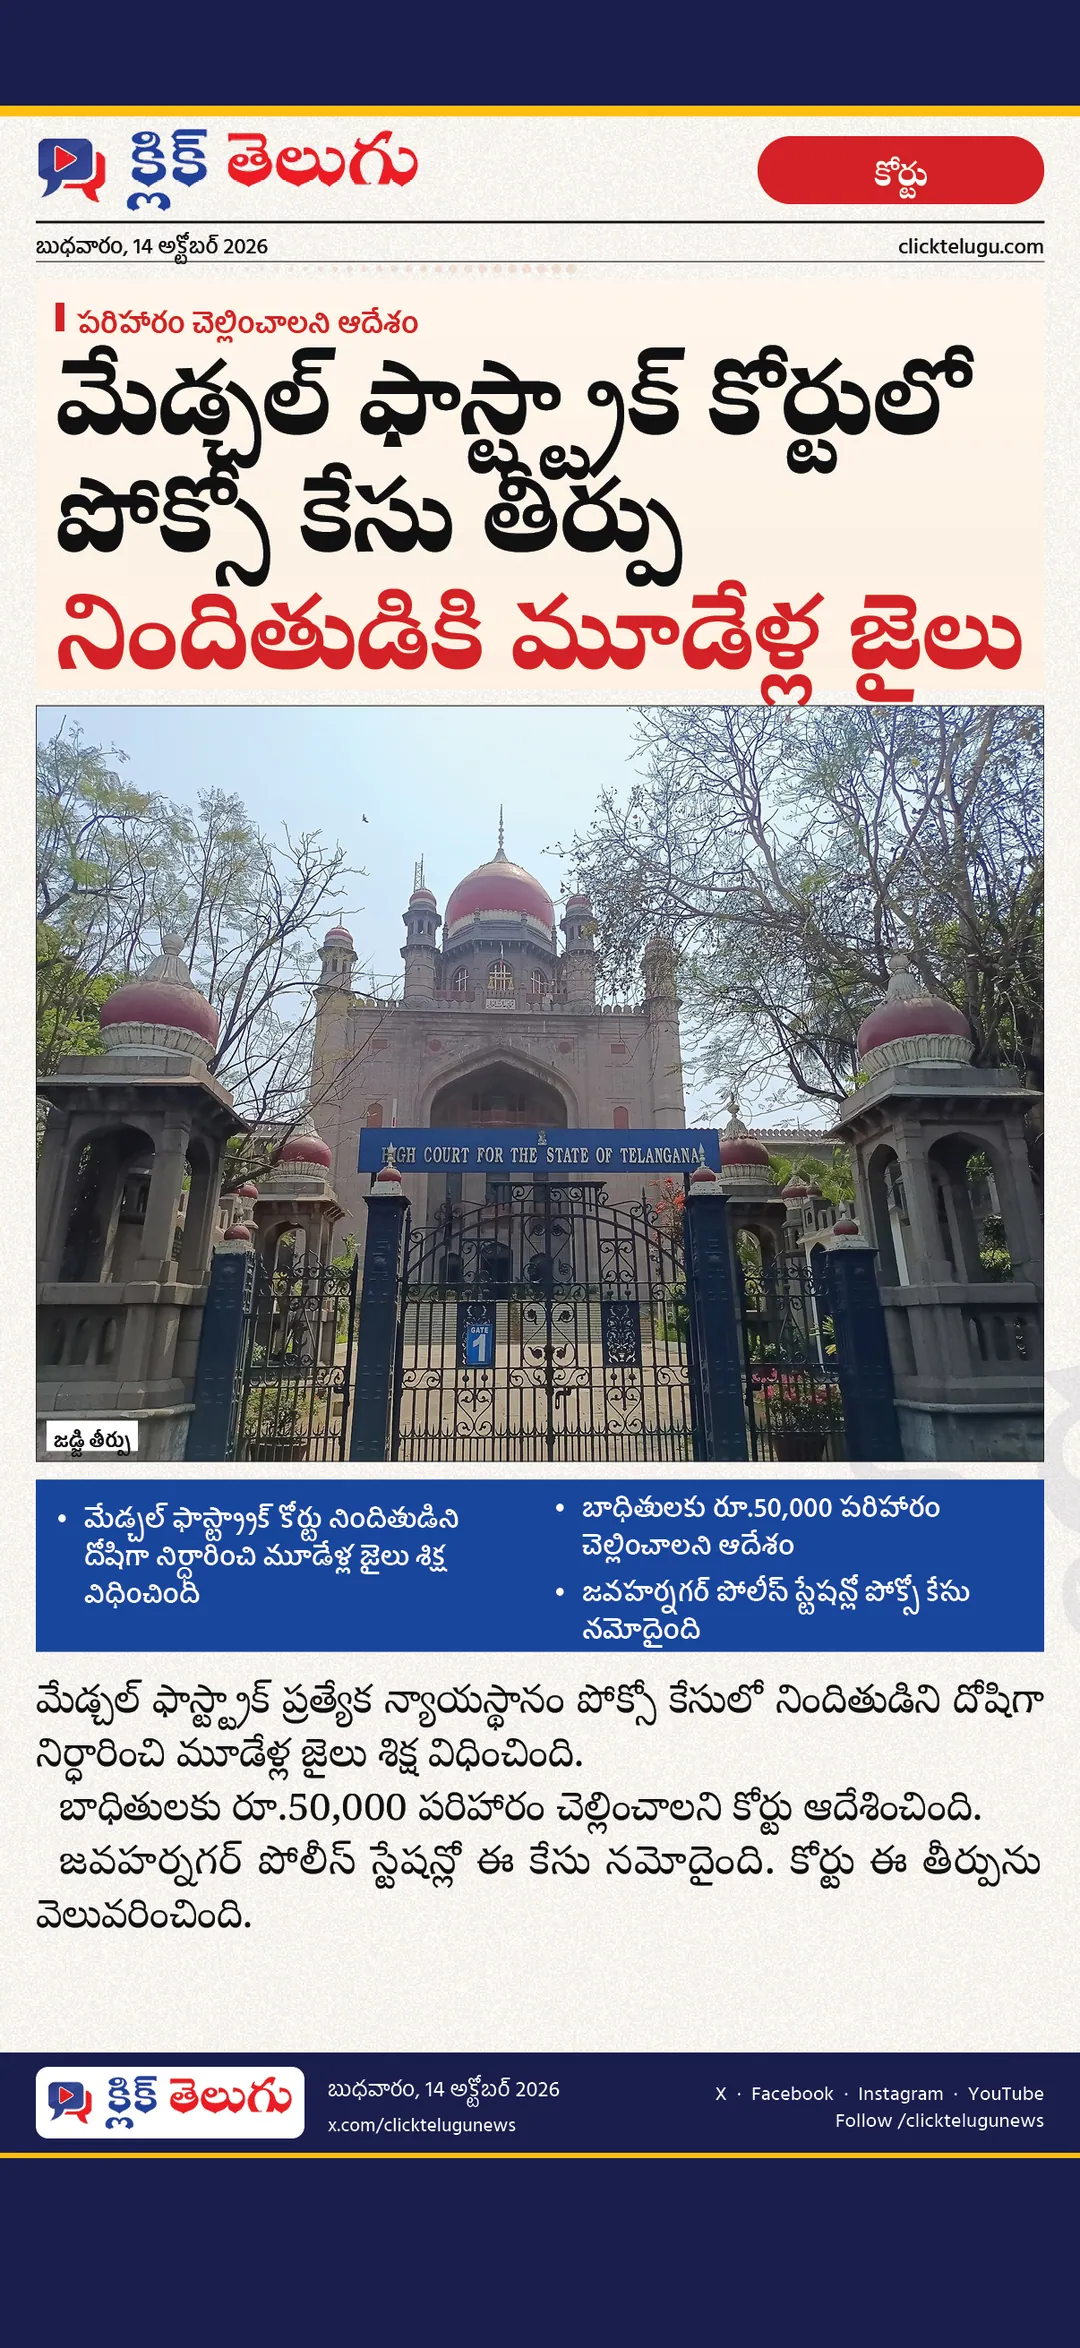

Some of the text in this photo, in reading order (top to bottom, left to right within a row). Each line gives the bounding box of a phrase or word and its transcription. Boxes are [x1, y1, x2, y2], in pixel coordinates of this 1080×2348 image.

[126, 128, 419, 211] క్లిక్ తెలుగు
[874, 155, 928, 200] కోర్టు
[36, 231, 269, 265] బుధవారం, 14 అక్టోబర్ 2026
[898, 237, 1044, 258] clicktelugu.com
[77, 306, 419, 343] పరిహారం చెల్లించాలని ఆదేశం
[57, 345, 336, 470] మేడ్చల్
[708, 344, 975, 475] కోర్టులో
[57, 462, 683, 588] పోక్సో కేసు తీర్పు
[57, 579, 1023, 706] నిందితుడికి మూడేళ్ల జైలు
[424, 1147, 469, 1163] COURT
[477, 1147, 503, 1163] FOR
[510, 1147, 537, 1163] THE
[547, 1147, 589, 1163] STATE
[596, 1147, 613, 1163] OF
[620, 1147, 700, 1164] TELANGANA
[473, 1334, 486, 1361] 1
[84, 1502, 168, 1543] మేడ్చల్
[278, 1500, 322, 1542] కోర్టు
[329, 1503, 459, 1530] నిందితుడిని
[582, 1494, 941, 1523] బాధితులకు రూ.50,000 పరిహారం
[84, 1538, 448, 1584] దోషిగా నిర్ధారించి మూడేళ్ల జైలు శిక్ష
[582, 1528, 795, 1564] చెల్లించాలని ఆదేశం
[84, 1581, 200, 1609] విధించింది
[582, 1573, 970, 1617] జవహర్నగర్ పోలీస్ స్టేషన్లో పోక్సో కేసు
[582, 1617, 701, 1649] నమోదైంది
[36, 1678, 143, 1727] మేడ్చల్
[282, 1678, 374, 1728] ప్రత్యేక
[384, 1683, 564, 1732] న్యాయస్థానం
[577, 1678, 657, 1726] పోక్సో
[669, 1678, 765, 1714] కేసులో
[776, 1681, 940, 1714] నిందితుడిని
[953, 1678, 1045, 1719] దోషిగా
[36, 1733, 583, 1785] నిర్ధారించి మూడేళ్ల జైలు శిక్ష విధించింది.
[59, 1786, 981, 1836] బాధితులకు రూ.50,000 పరిహారం చెల్లించాలని కోర్టు ఆదేశించింది.
[59, 1839, 1041, 1890] జవహర్నగర్ పోలీస్ స్టేషన్లో ఈ కేసు నమోదైంది. కోర్టు ఈ తీర్పును
[36, 1898, 251, 1929] వెలువరించింది.
[104, 2075, 293, 2129] క్లిక్ తెలుగు
[328, 2074, 560, 2108] బుధవారం, 14 అక్టోబర్ 2026
[715, 2085, 1044, 2105] X Facebook Instagram YouTube
[328, 2117, 516, 2136] x.com/clicktelugunews
[836, 2112, 1044, 2131] Follow /clicktelugunews
